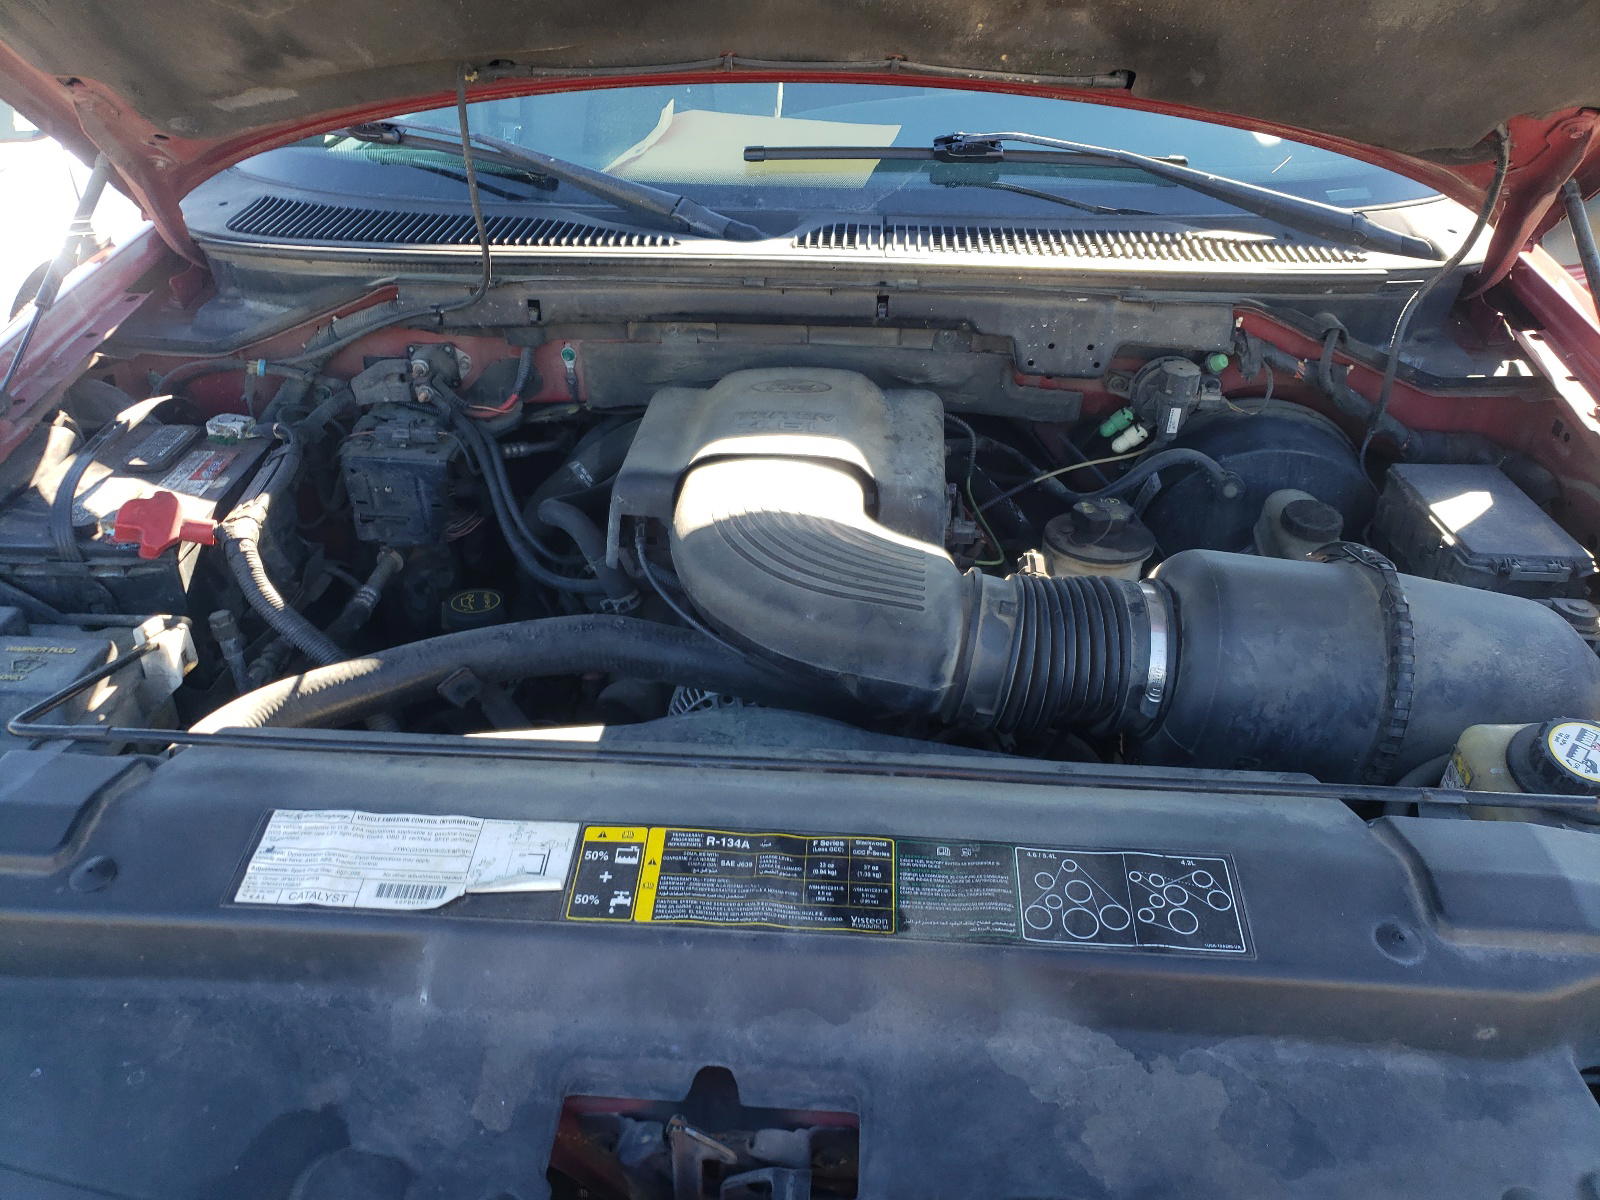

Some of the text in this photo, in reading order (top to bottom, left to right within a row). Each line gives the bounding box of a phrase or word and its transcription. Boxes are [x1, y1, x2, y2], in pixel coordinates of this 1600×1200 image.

[706, 835, 750, 850] R-134A
[584, 851, 609, 861] 50%
[1180, 859, 1196, 867] 4.2L
[288, 891, 348, 903] CATALYST
[574, 894, 600, 905] 50%
[850, 915, 889, 925] Visteon
